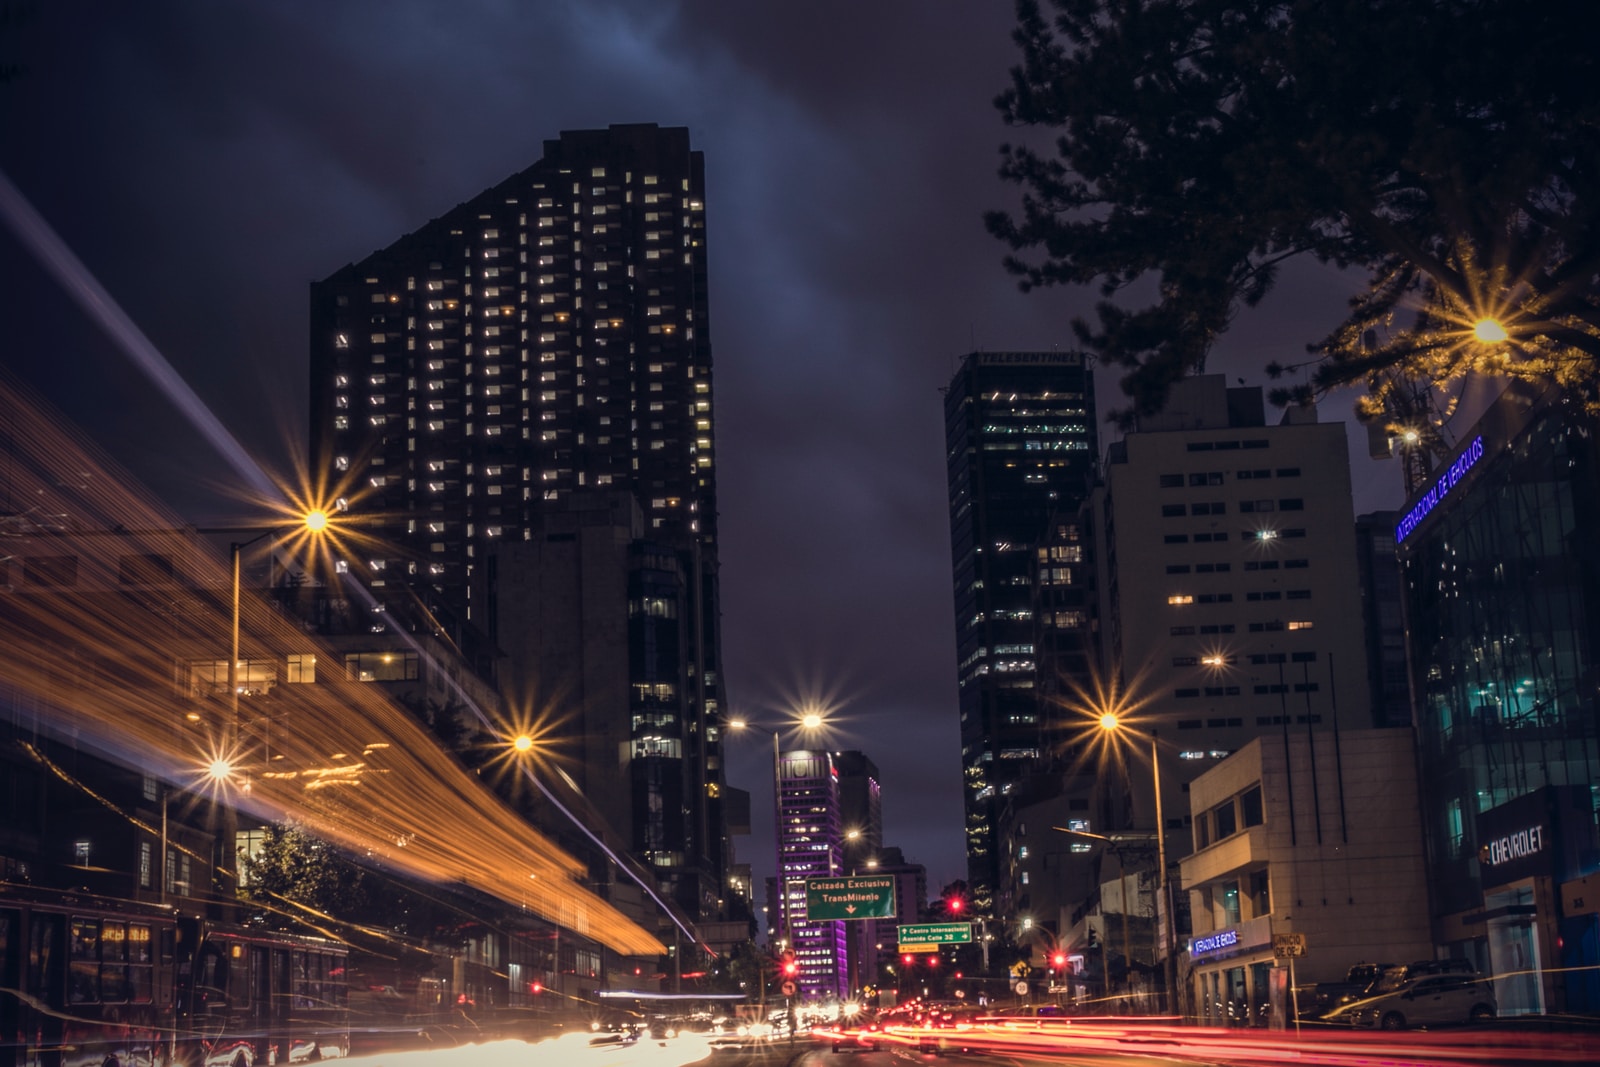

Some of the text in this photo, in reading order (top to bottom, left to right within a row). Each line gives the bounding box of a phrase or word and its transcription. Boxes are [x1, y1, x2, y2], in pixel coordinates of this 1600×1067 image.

[983, 353, 1076, 363] TELESENTINEL
[1395, 435, 1483, 544] INTERNACIONAL DE VEHICULOS
[1490, 825, 1543, 866] CHEVROLET
[809, 879, 891, 890] Calzada Exclusiva
[822, 893, 880, 903] TransMilenio
[930, 926, 968, 934] Internacional
[927, 934, 943, 942] Calle
